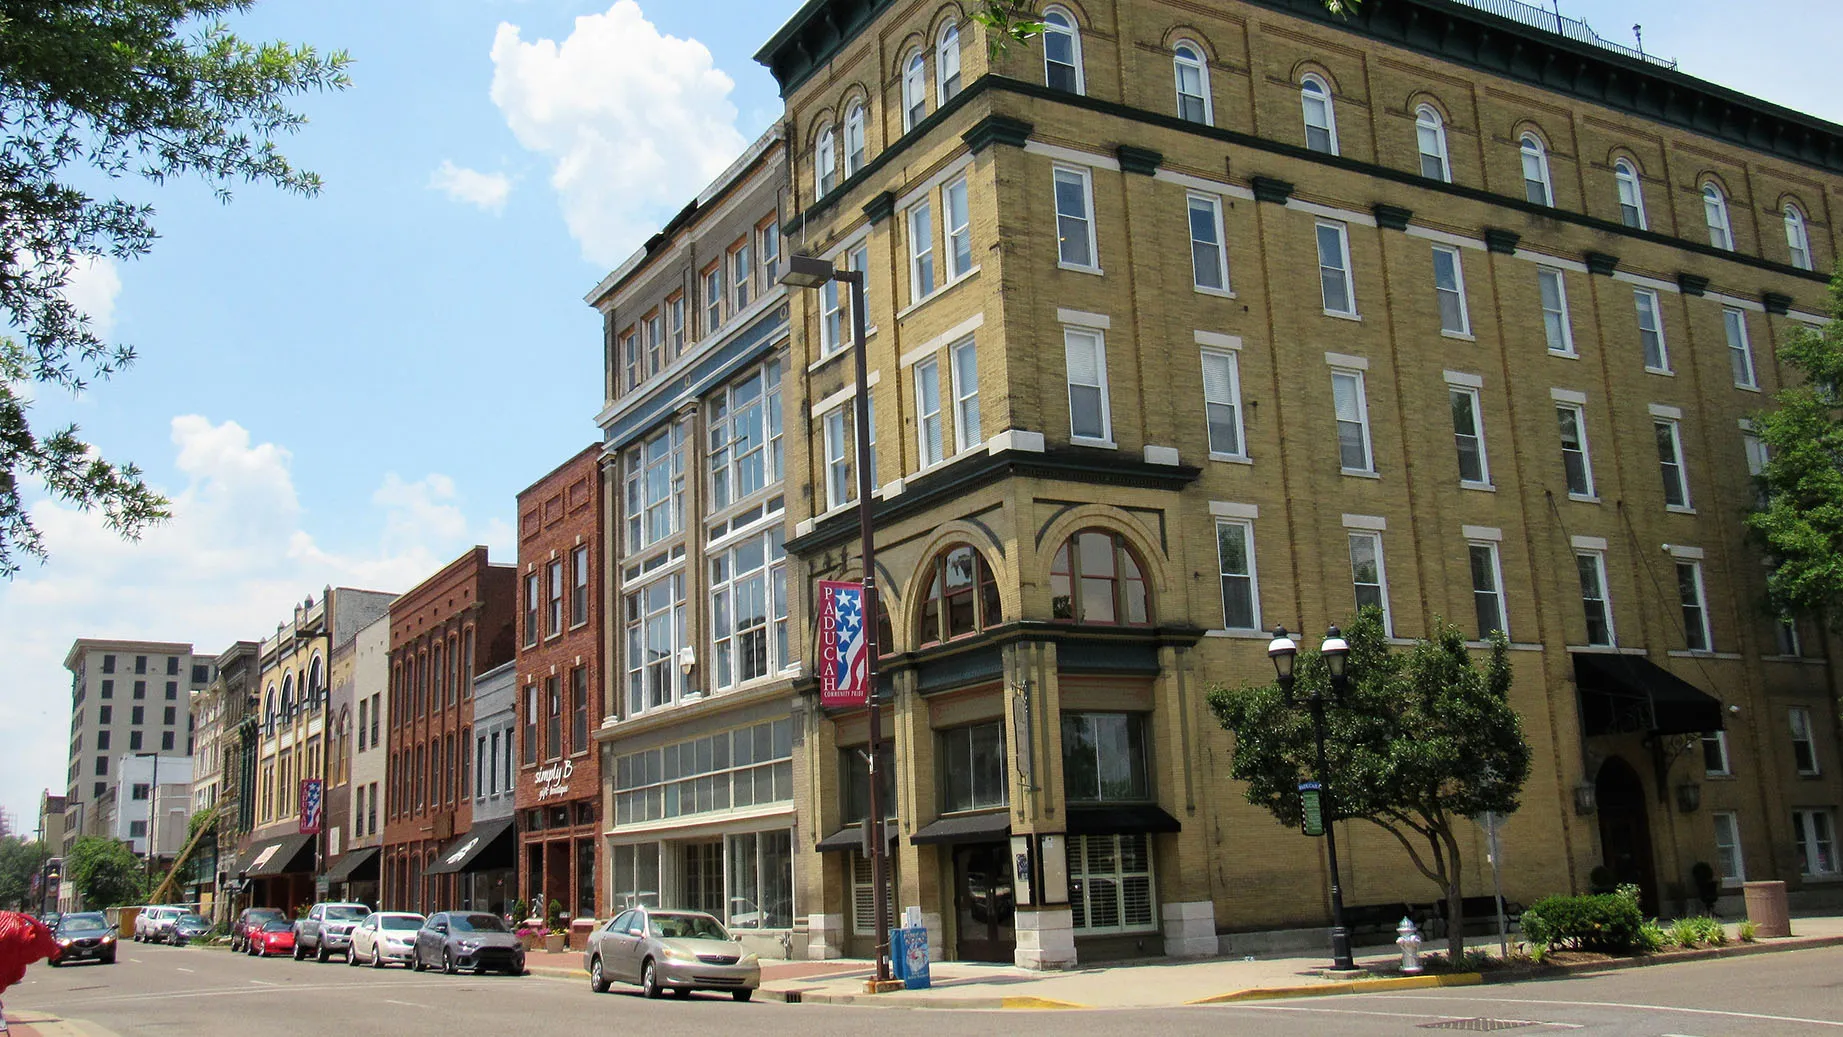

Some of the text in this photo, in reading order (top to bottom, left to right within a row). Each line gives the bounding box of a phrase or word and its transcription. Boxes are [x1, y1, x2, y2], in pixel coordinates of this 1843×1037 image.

[824, 587, 835, 690] PADUCAH
[535, 760, 573, 788] simply B
